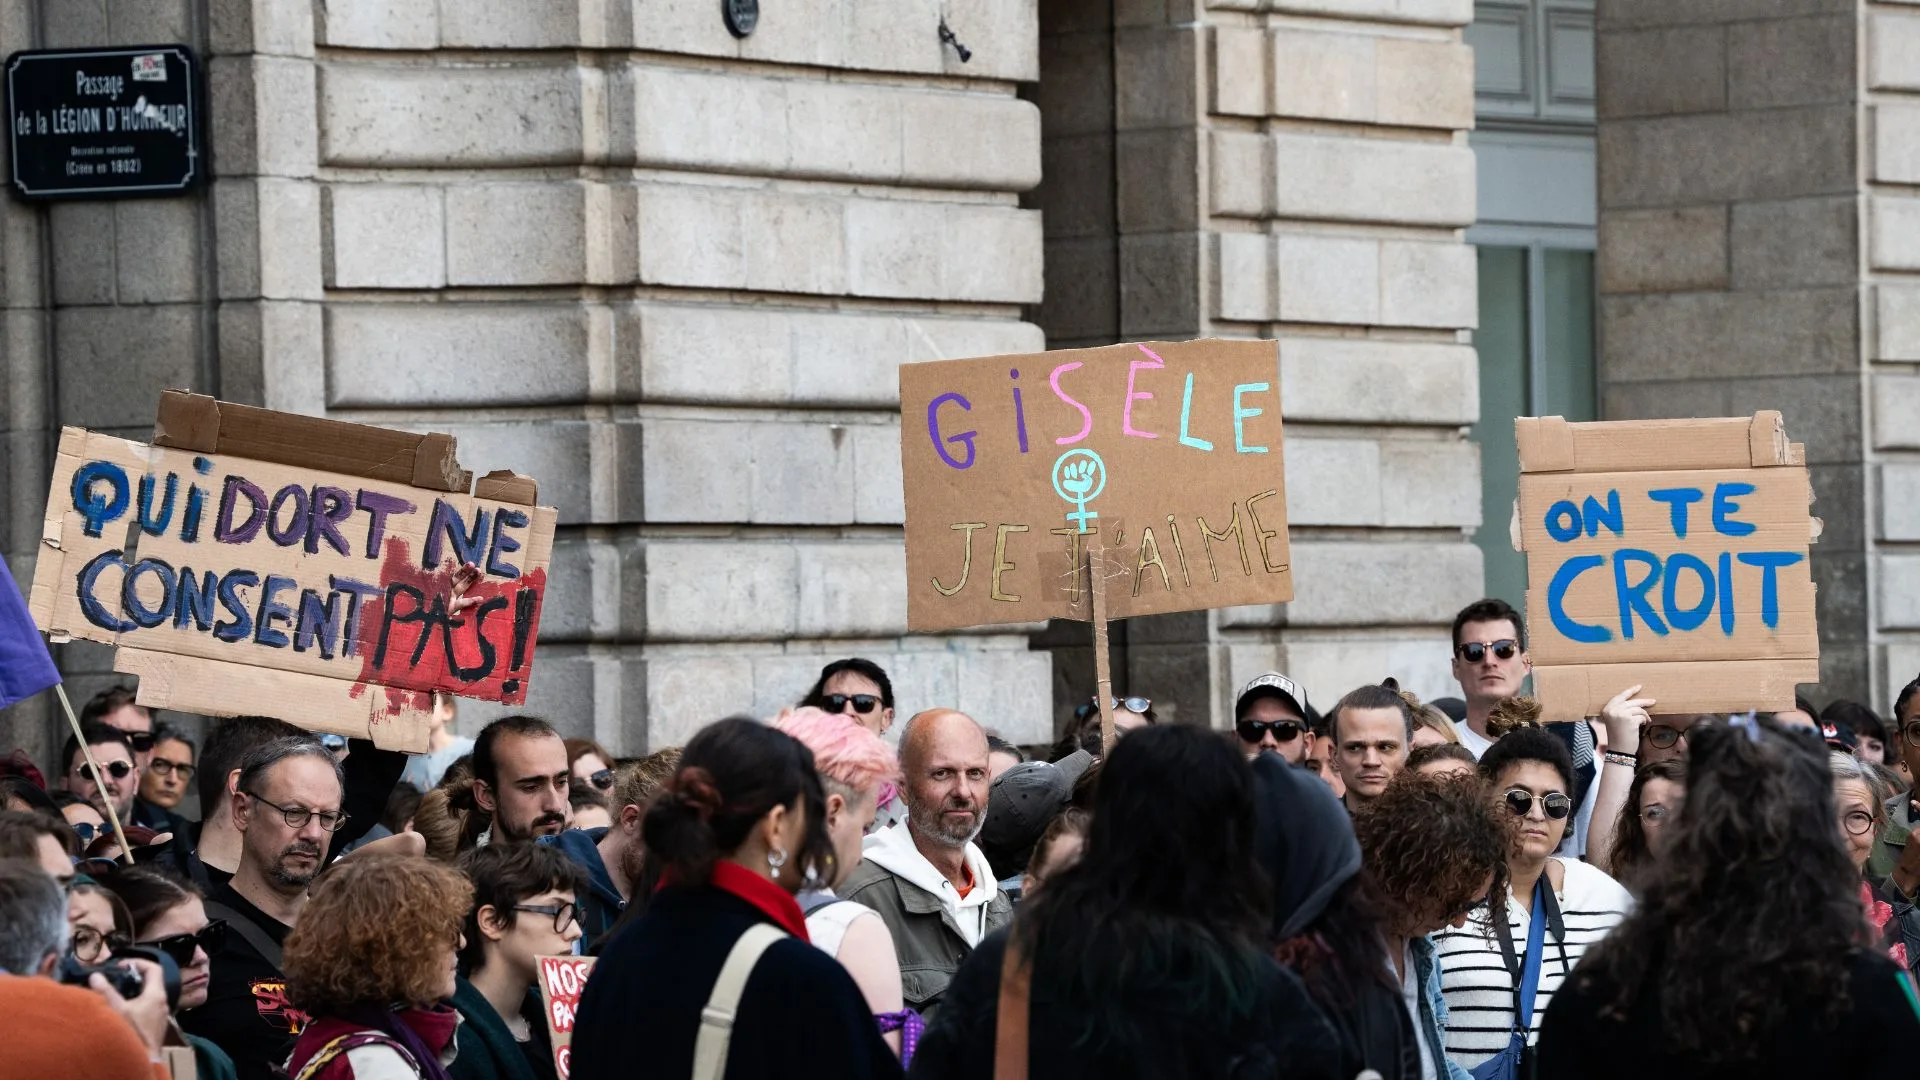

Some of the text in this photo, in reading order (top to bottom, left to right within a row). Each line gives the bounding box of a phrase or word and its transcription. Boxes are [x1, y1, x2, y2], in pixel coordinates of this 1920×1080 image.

[76, 70, 124, 101] Passage
[17, 111, 31, 135] de
[36, 110, 47, 134] la
[52, 104, 101, 134] LÉGION
[111, 158, 142, 174] 1802)
[214, 474, 418, 560] DORT
[421, 497, 530, 579] NE
[1544, 482, 1758, 543] ON TE
[930, 522, 1030, 602] JE
[76, 548, 386, 660] CONSENT
[1547, 548, 1804, 643] CROIT
[551, 999, 580, 1030] PA
